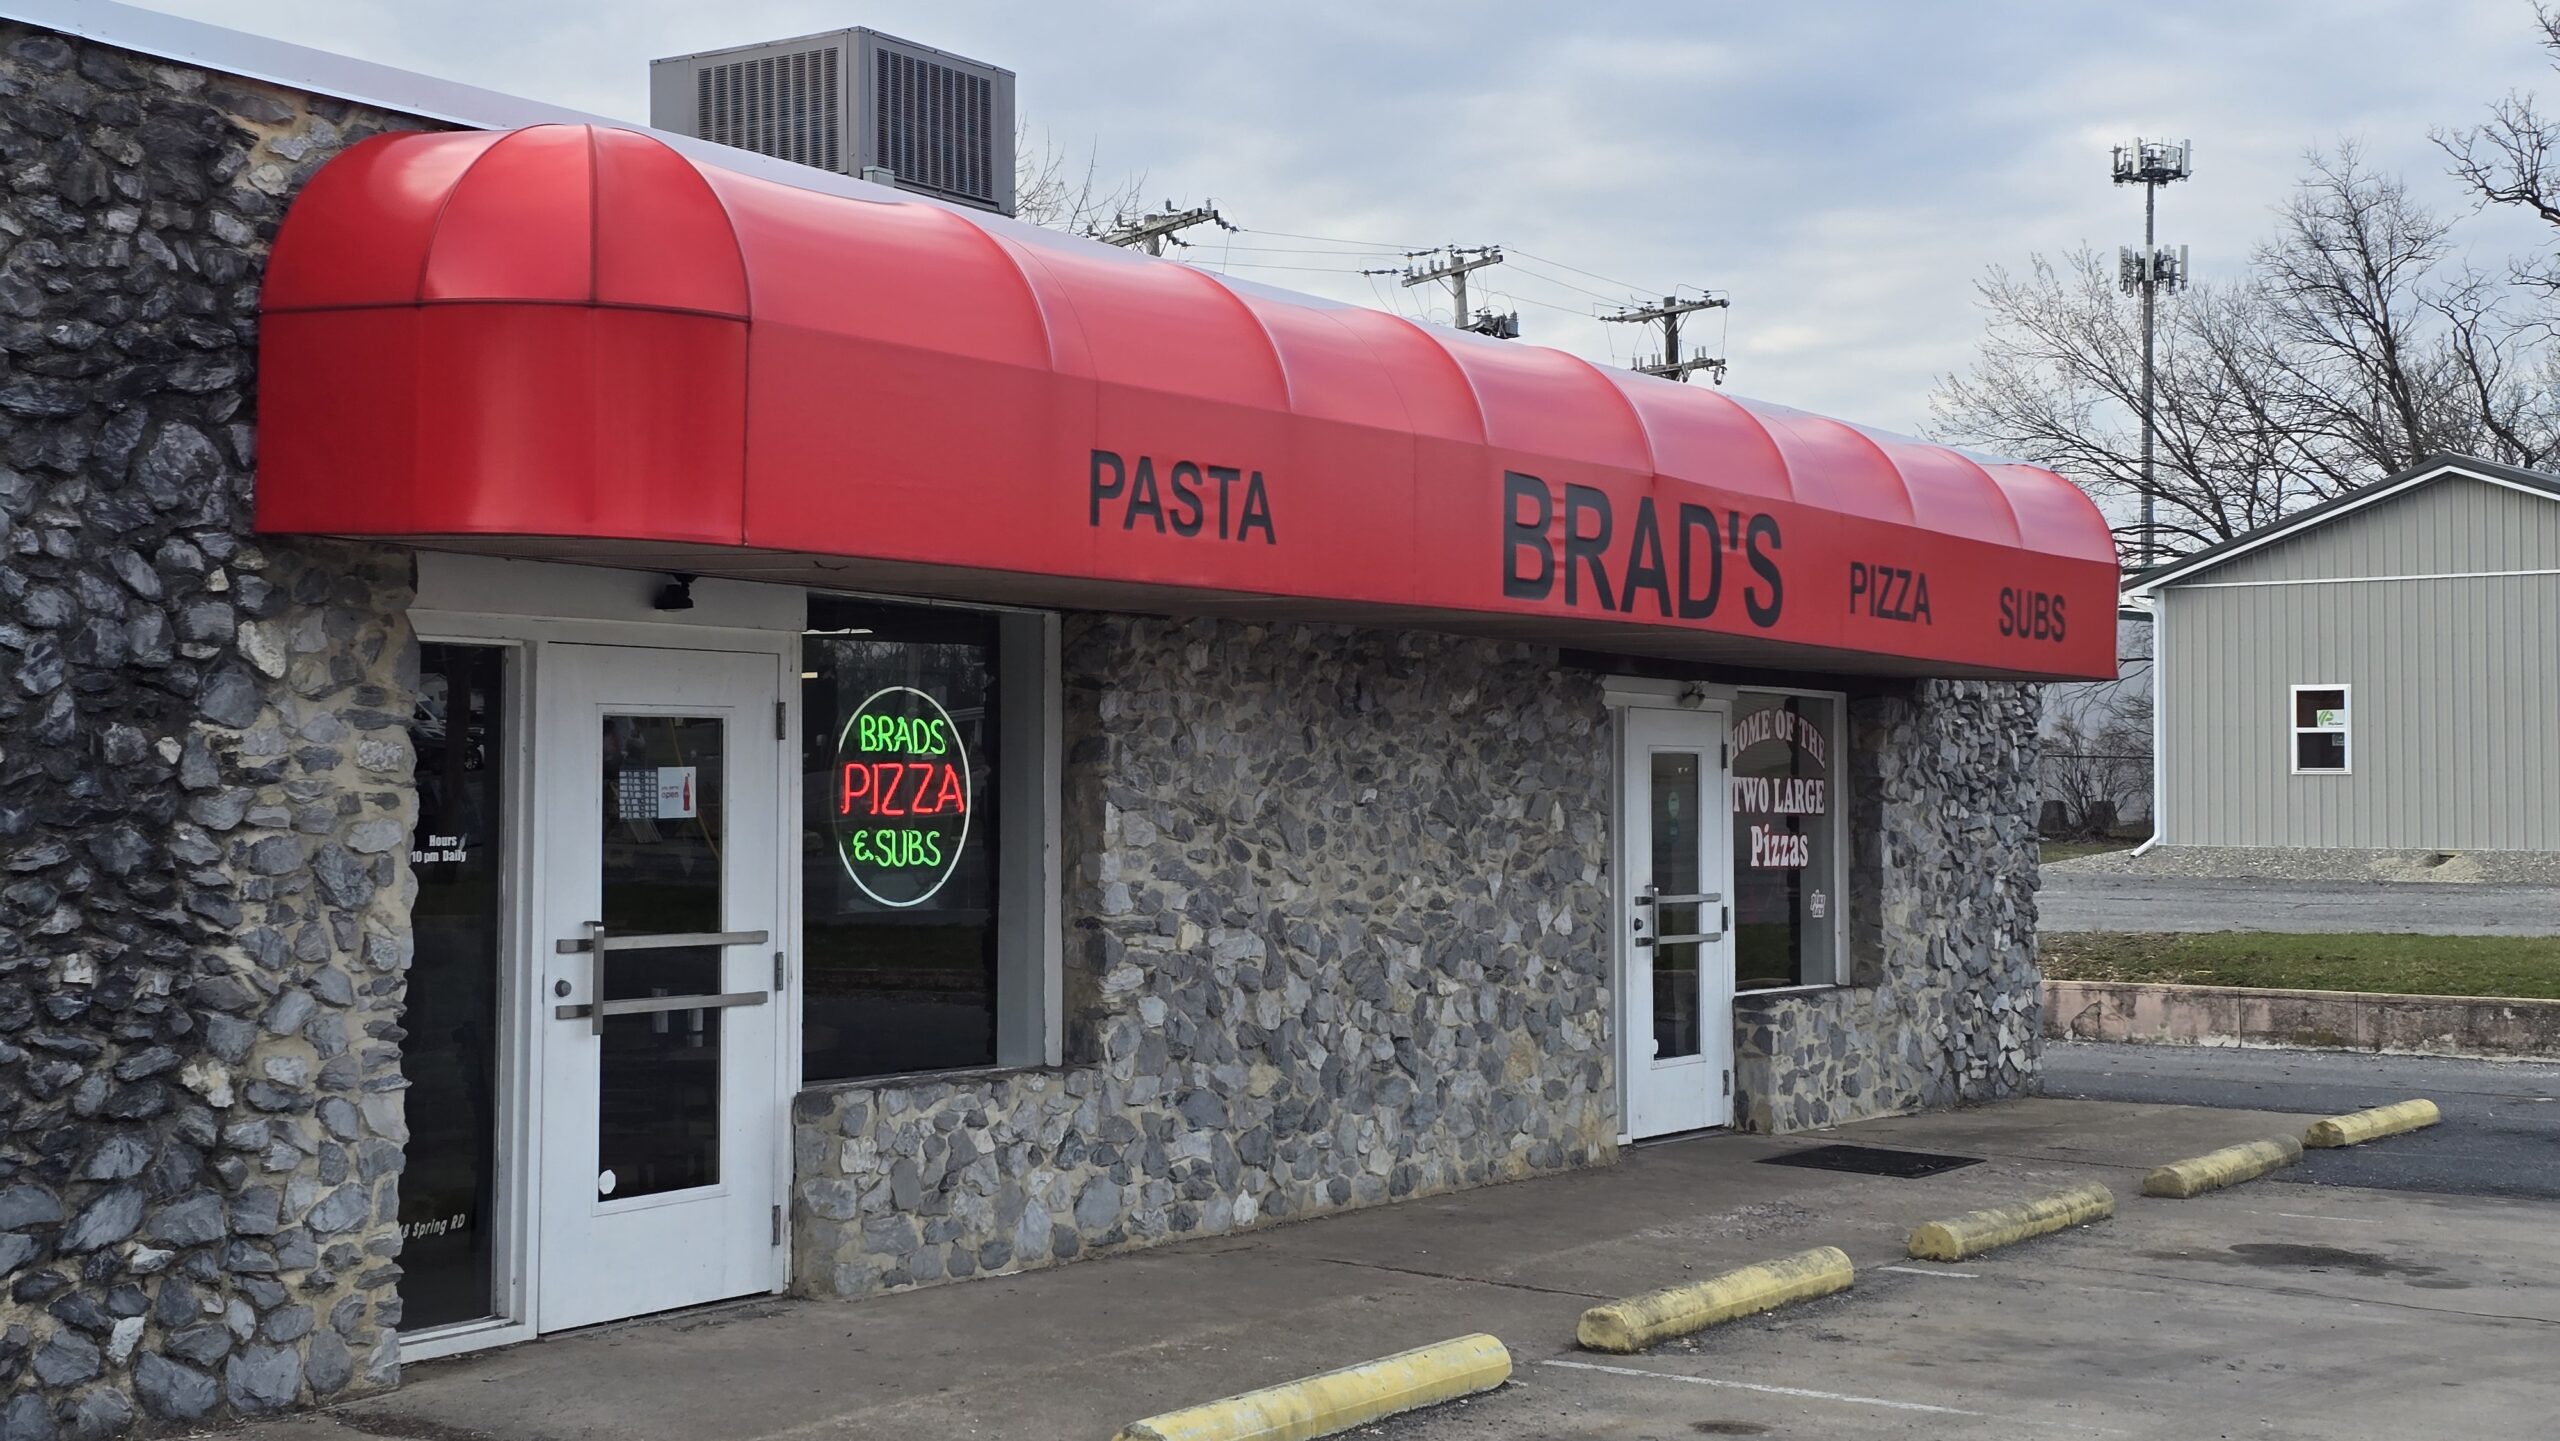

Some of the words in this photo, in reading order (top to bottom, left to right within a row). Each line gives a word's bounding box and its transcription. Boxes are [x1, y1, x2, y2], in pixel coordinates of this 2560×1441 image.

[1089, 449, 1276, 545] PASTA
[1502, 470, 1784, 629] BRAD'S
[1849, 561, 1932, 626] PIZZA
[1998, 586, 2066, 643] SUBS
[860, 714, 947, 755] BRADS
[1732, 709, 1771, 760] HOME
[1774, 708, 1796, 742] OF
[1798, 717, 1826, 769] THE
[840, 762, 965, 816] PIZZA
[1732, 776, 1769, 813] TWO
[1773, 777, 1825, 814] LARGE
[424, 851, 439, 864] pm
[442, 850, 467, 863] Daily
[429, 835, 458, 847] Hours
[1750, 823, 1809, 867] Pizzas
[412, 1218, 448, 1239] Spring
[450, 1213, 466, 1230] RD
